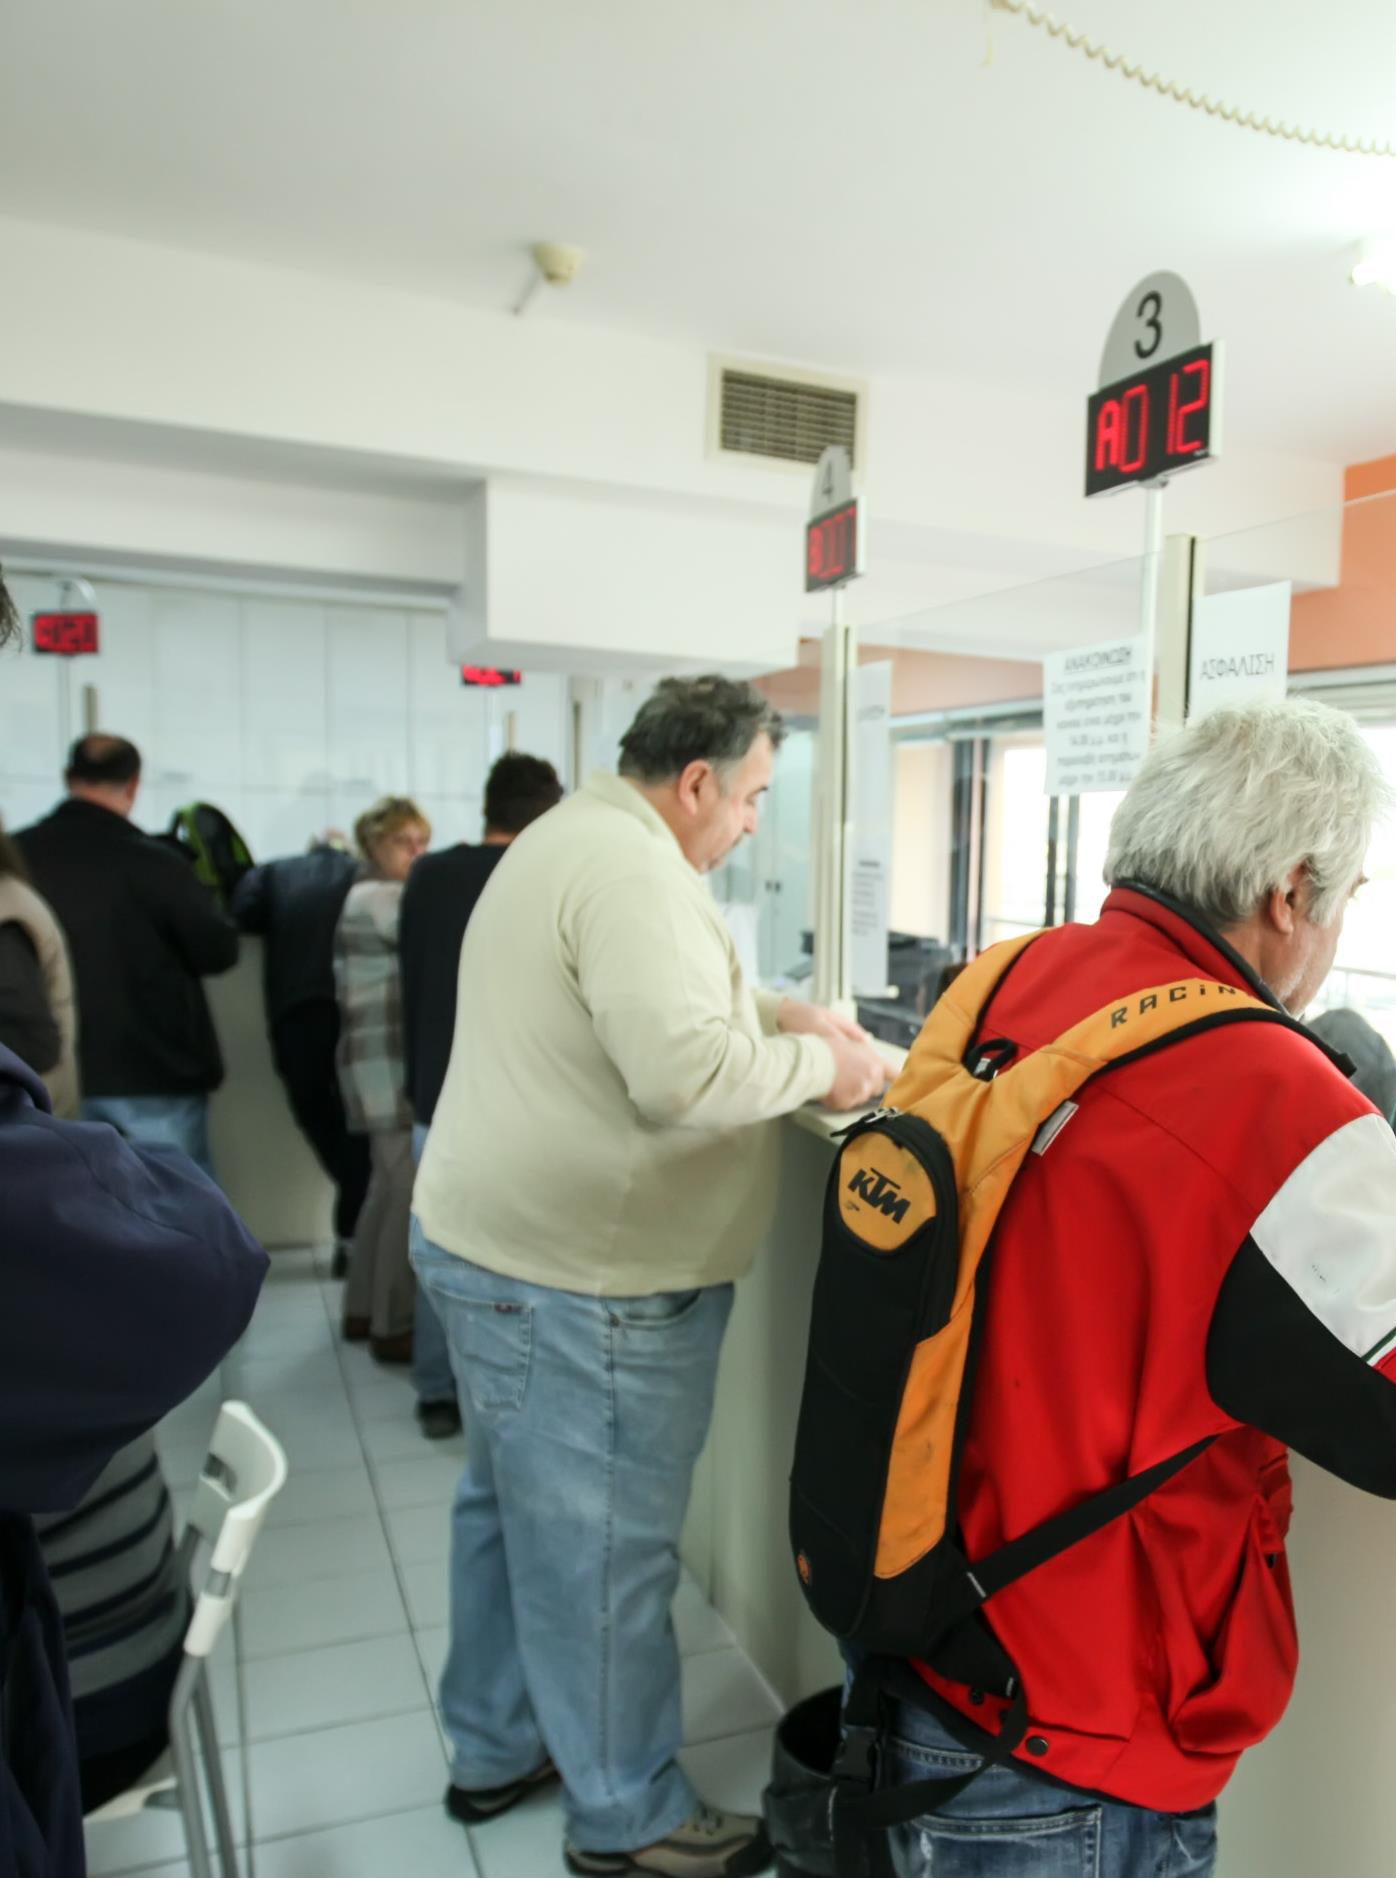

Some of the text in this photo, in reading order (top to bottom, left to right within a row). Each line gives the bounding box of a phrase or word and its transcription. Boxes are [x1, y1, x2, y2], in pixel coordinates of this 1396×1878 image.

[1134, 290, 1163, 360] 3
[1200, 652, 1276, 680] ΑΣΦΑΛΙΣΗ
[848, 1166, 911, 1225] KTM
